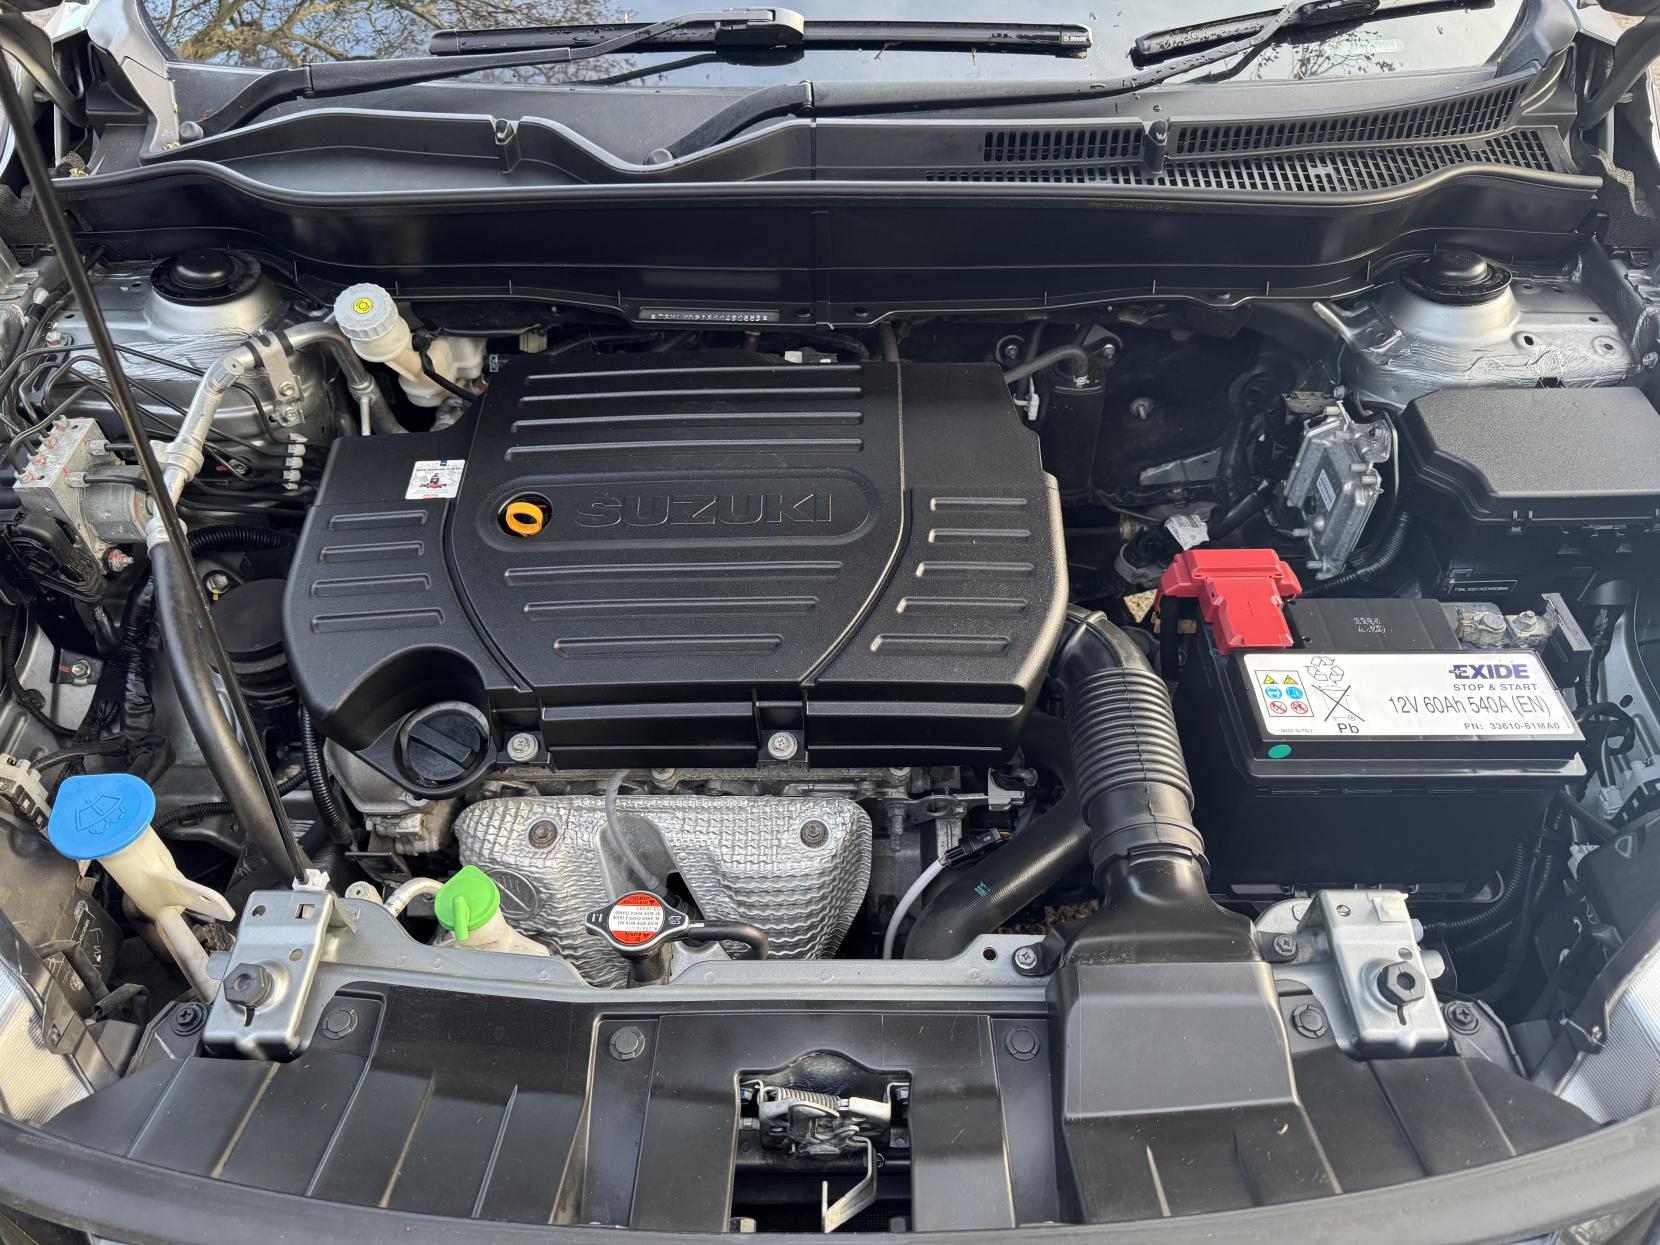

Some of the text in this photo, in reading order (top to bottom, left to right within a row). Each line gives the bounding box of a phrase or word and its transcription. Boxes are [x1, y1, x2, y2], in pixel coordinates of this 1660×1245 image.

[574, 492, 833, 528] SUZUKI
[1449, 663, 1530, 680] EXIDE
[1453, 683, 1538, 692] STOP & START
[1388, 695, 1550, 716] 12V 60Ah 540A (EN)
[1337, 722, 1359, 735] Pb
[1464, 723, 1484, 731] PN:
[1489, 722, 1560, 731] 33610-61MA0
